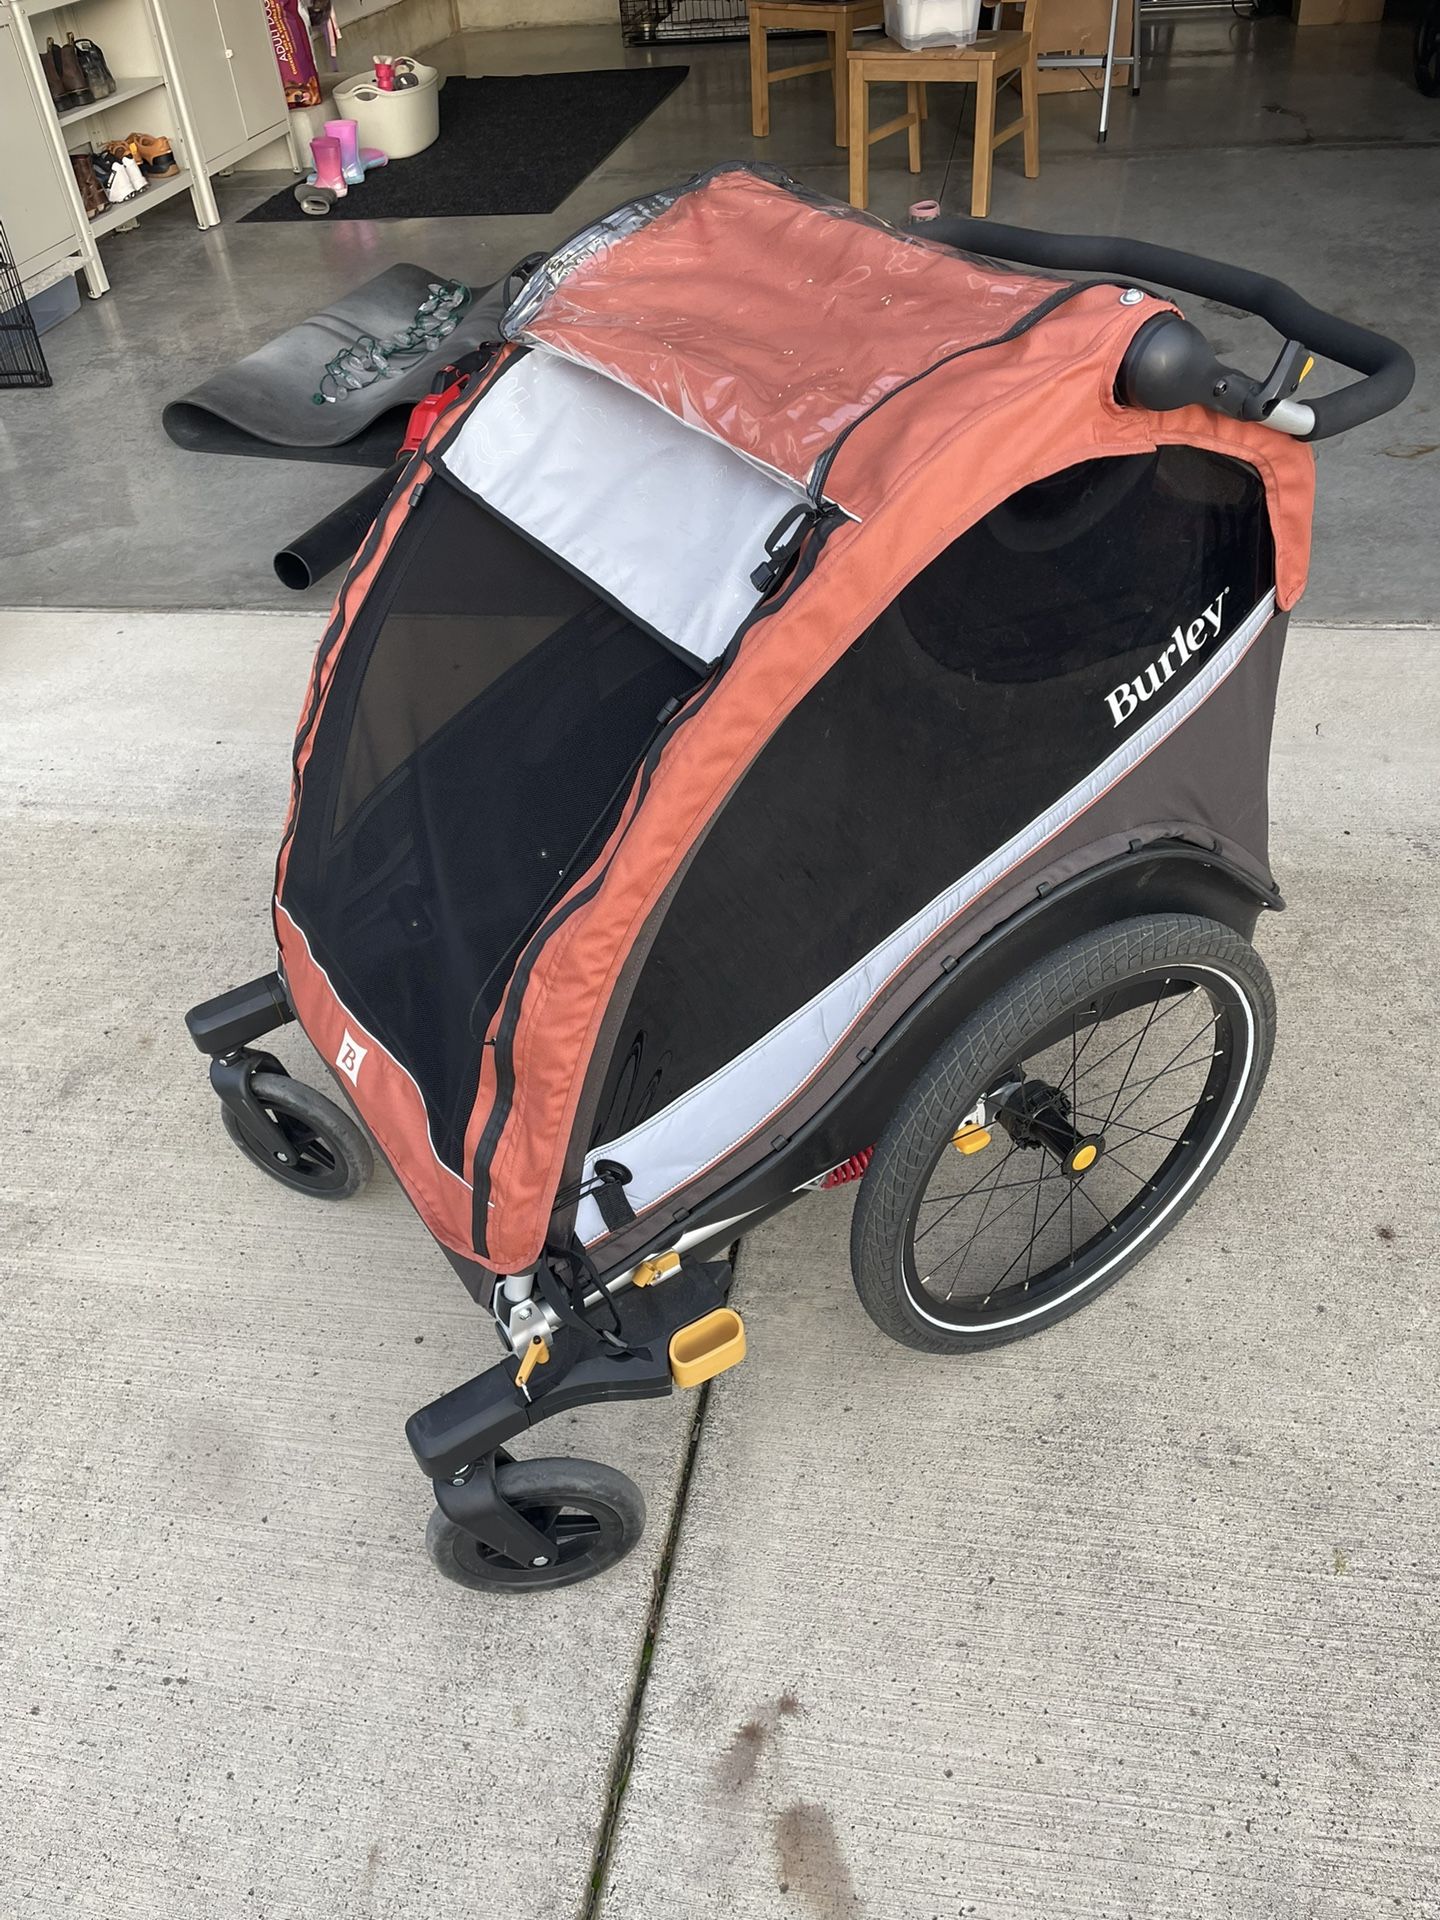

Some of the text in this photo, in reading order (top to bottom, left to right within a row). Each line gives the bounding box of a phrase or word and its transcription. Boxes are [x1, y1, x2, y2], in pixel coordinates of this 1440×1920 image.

[270, 29, 289, 62] ADULT
[1104, 592, 1225, 729] Burley
[341, 1042, 356, 1071] B
